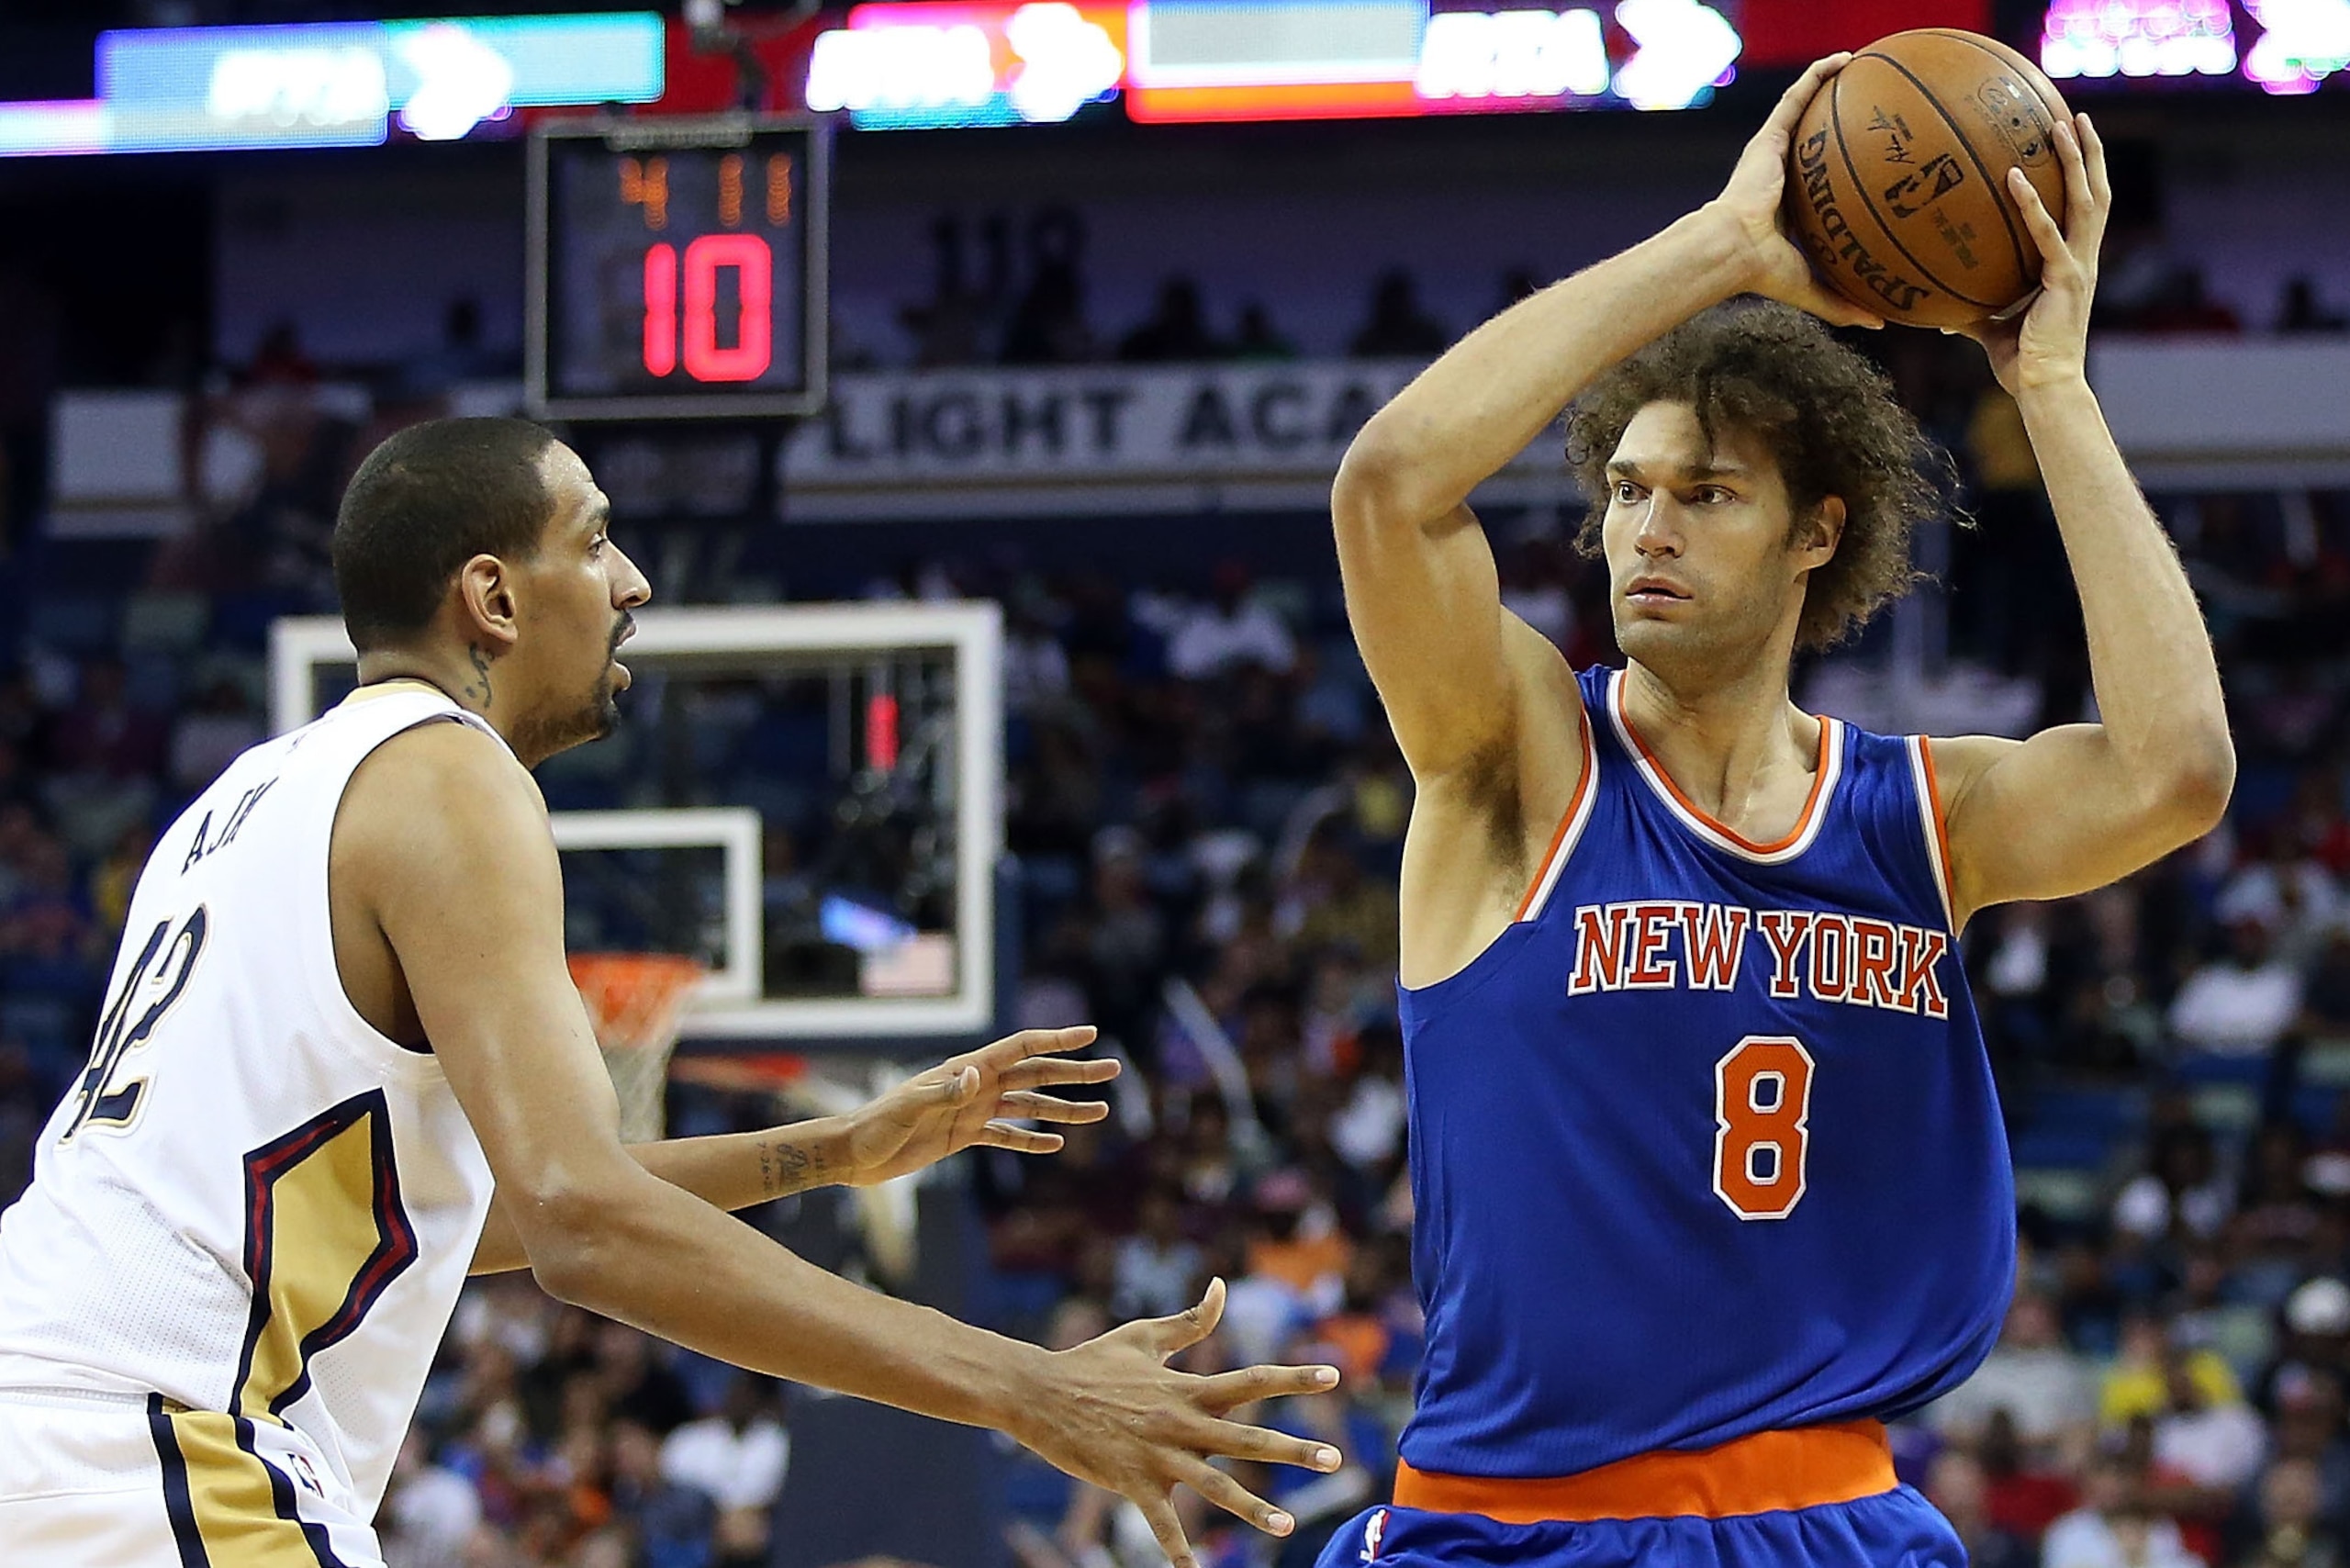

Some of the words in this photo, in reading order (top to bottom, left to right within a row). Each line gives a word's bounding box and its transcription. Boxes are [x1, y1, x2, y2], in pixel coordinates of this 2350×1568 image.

[619, 157, 669, 229] 4
[719, 152, 791, 227] 11
[1798, 129, 1931, 311] SPALDING
[643, 234, 772, 382] 10
[830, 382, 1140, 458] LIGHT
[59, 902, 209, 1145] 42
[1567, 899, 1750, 996] NEW
[1757, 910, 1948, 1020] YORK
[1713, 1035, 1816, 1220] 8
